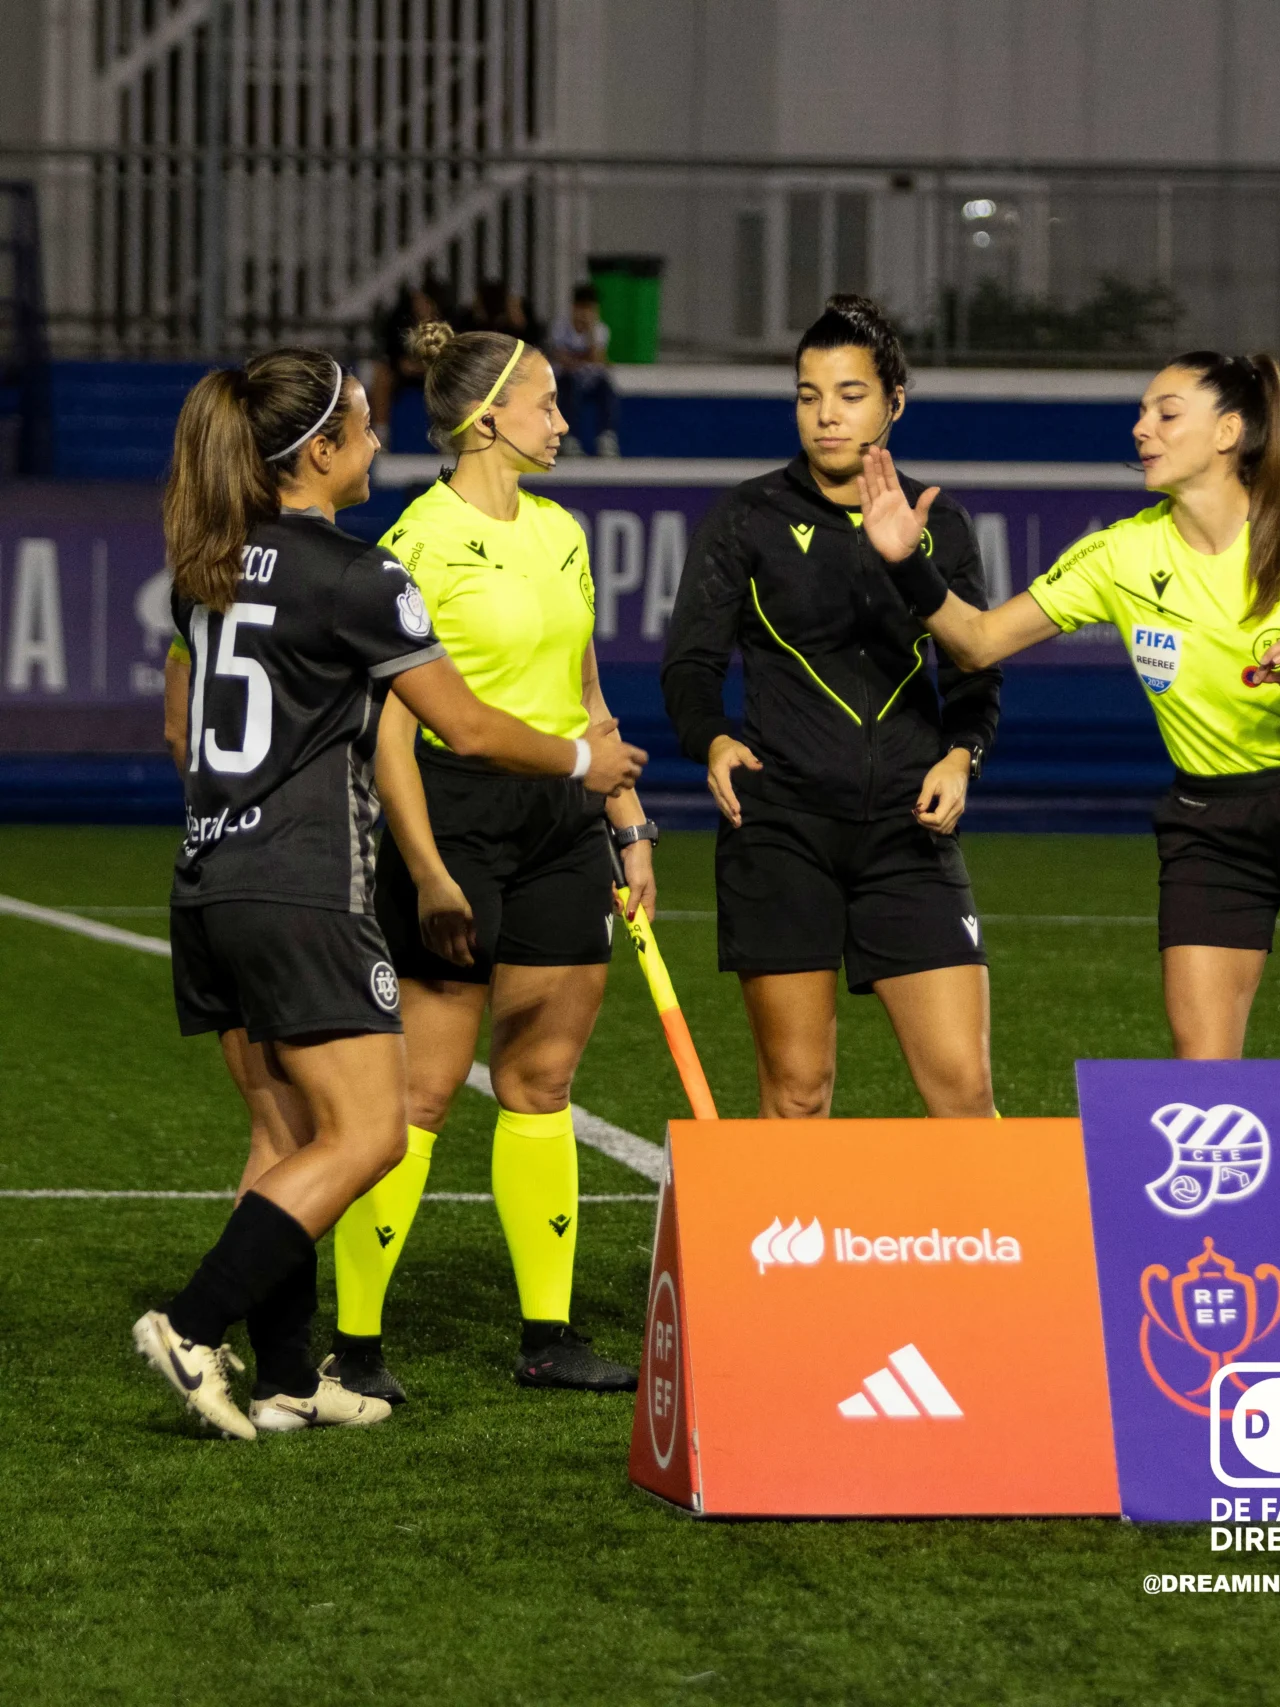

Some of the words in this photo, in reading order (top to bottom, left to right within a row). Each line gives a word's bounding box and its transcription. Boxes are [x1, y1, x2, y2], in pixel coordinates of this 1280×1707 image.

[407, 541, 425, 572] drola
[1062, 540, 1105, 573] Iberdrola
[1136, 629, 1176, 651] FIFA
[1136, 655, 1175, 670] REFEREE
[189, 602, 277, 773] 15
[1147, 677, 1165, 689] 2025
[834, 1227, 1022, 1263] Iberdrola
